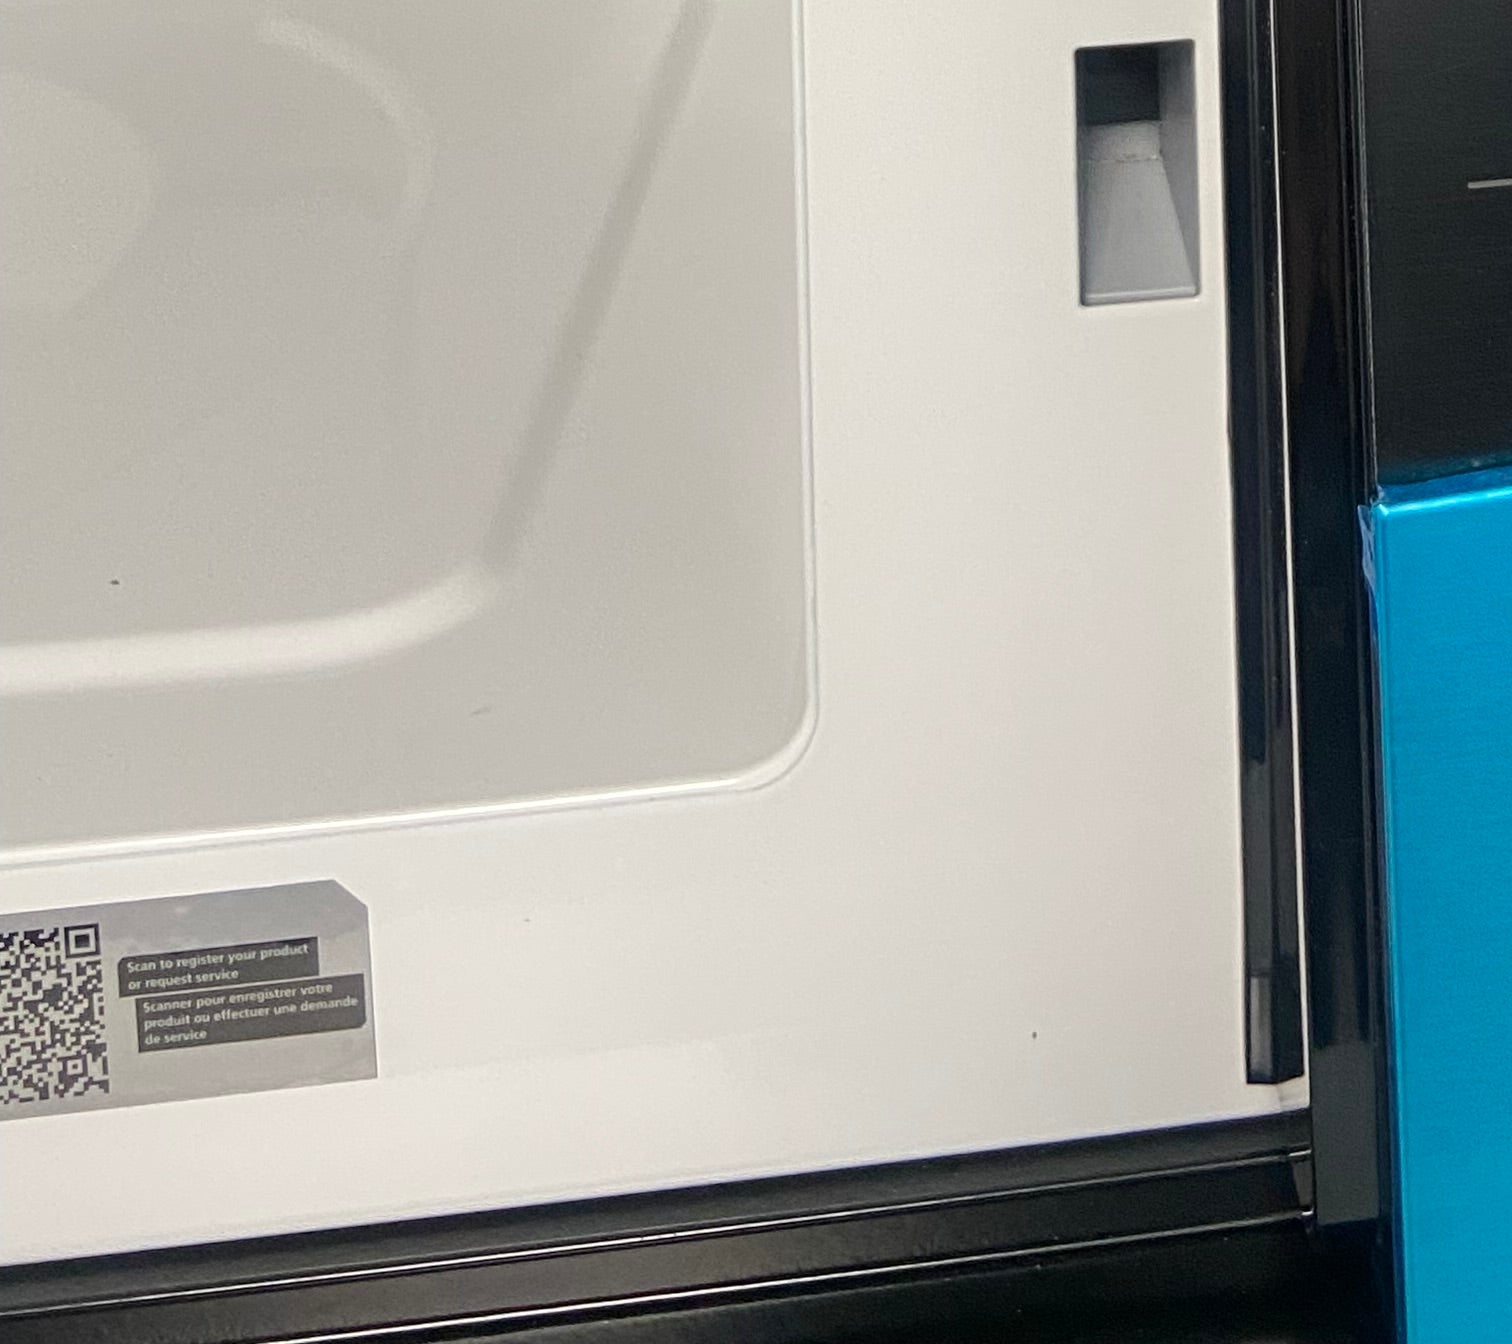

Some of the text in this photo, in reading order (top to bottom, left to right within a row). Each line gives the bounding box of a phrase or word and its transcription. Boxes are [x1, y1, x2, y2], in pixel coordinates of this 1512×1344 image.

[127, 944, 308, 973] Scan to register your product
[128, 970, 238, 990] or request service
[143, 984, 333, 1013] Scanner pour enregistrer votre
[144, 996, 359, 1031] produit ou effectuer une demande
[144, 1030, 207, 1045] de service
